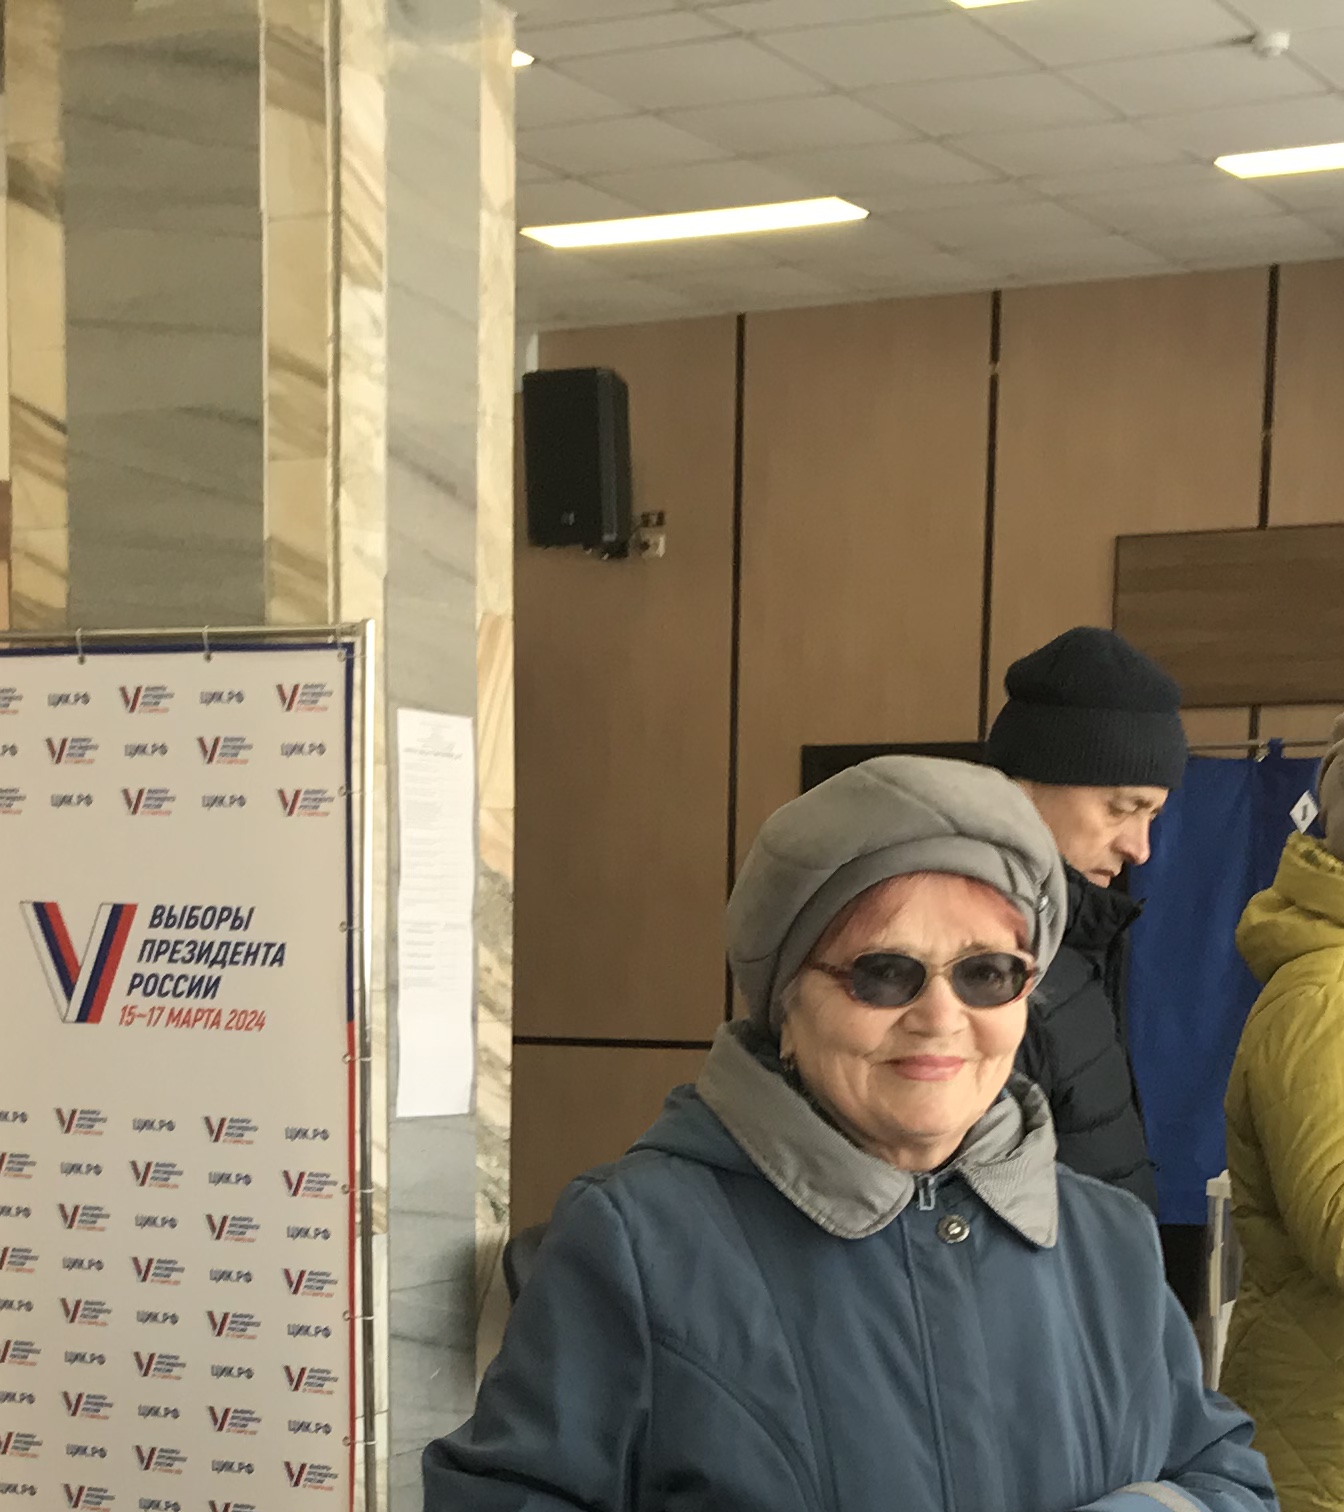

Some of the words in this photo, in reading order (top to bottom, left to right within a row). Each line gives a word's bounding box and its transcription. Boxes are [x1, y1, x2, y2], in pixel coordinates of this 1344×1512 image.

[147, 903, 256, 933] ВЫБОРЫ
[136, 938, 288, 970] ПРЕЗИДЕНТА
[125, 971, 222, 1001] РОССИИ
[165, 1007, 222, 1031] МАРТА
[224, 1008, 267, 1033] 2024
